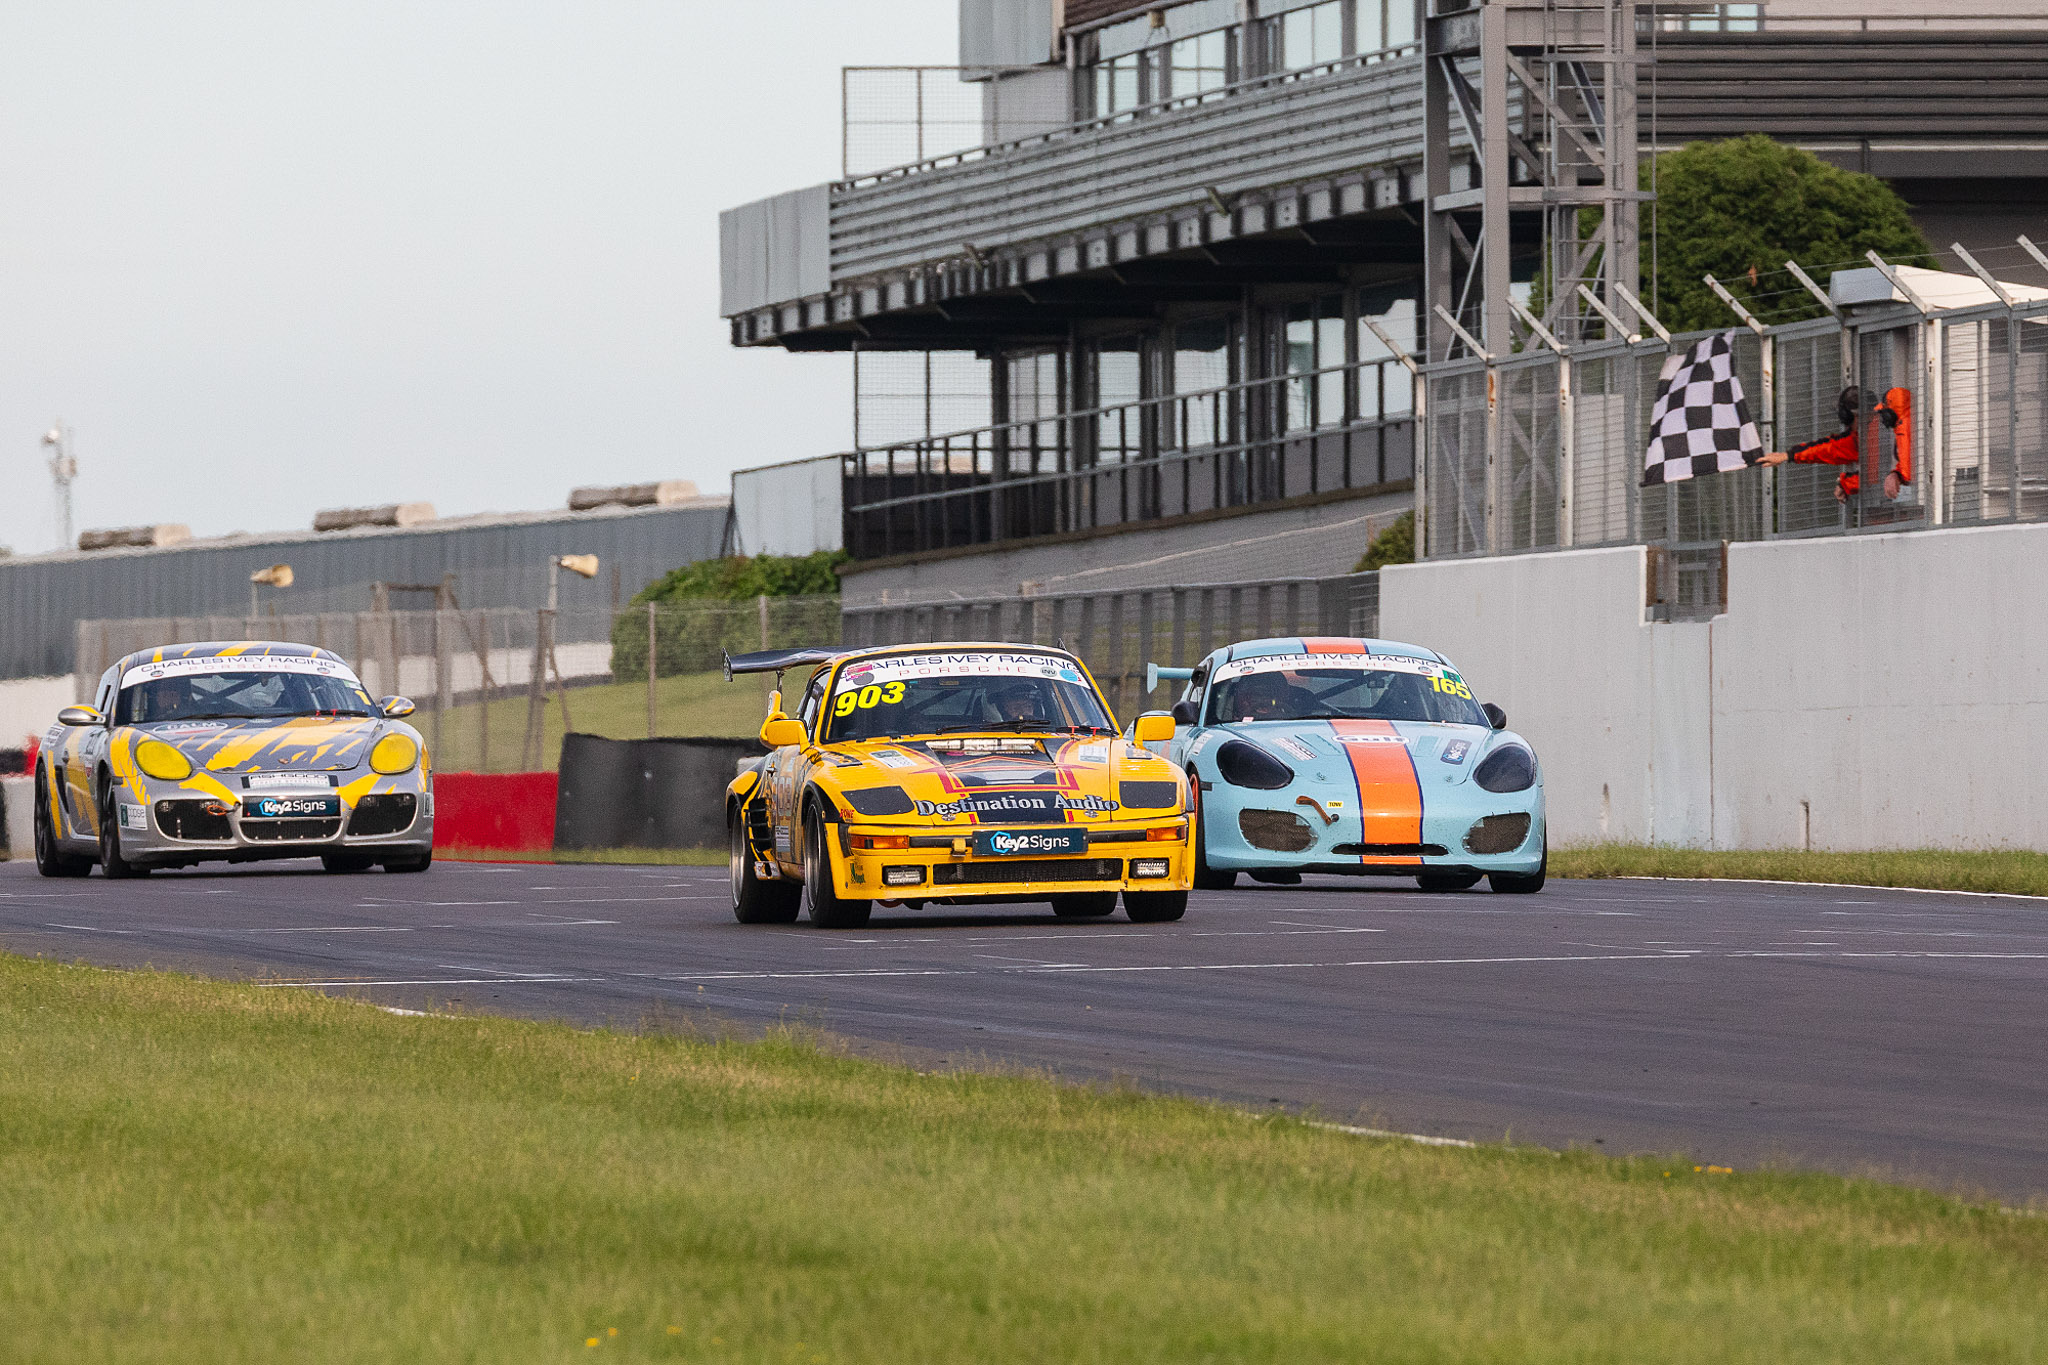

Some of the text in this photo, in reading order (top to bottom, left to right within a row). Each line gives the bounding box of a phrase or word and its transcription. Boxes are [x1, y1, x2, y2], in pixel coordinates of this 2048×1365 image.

[141, 658, 223, 673] CHARLES
[271, 657, 336, 669] RACING
[947, 655, 993, 664] IVEY
[1230, 654, 1318, 668] CHARLES
[1369, 654, 1439, 668] RACING
[1281, 660, 1392, 668] PORSCHE
[189, 663, 292, 671] PORSCHE
[899, 666, 1028, 676] PORSCHE
[1427, 676, 1472, 700] 165
[834, 681, 906, 717] 903
[264, 800, 326, 814] Key2Signs
[914, 794, 1120, 816] Destination Audio
[996, 835, 1070, 853] Key2Signs
